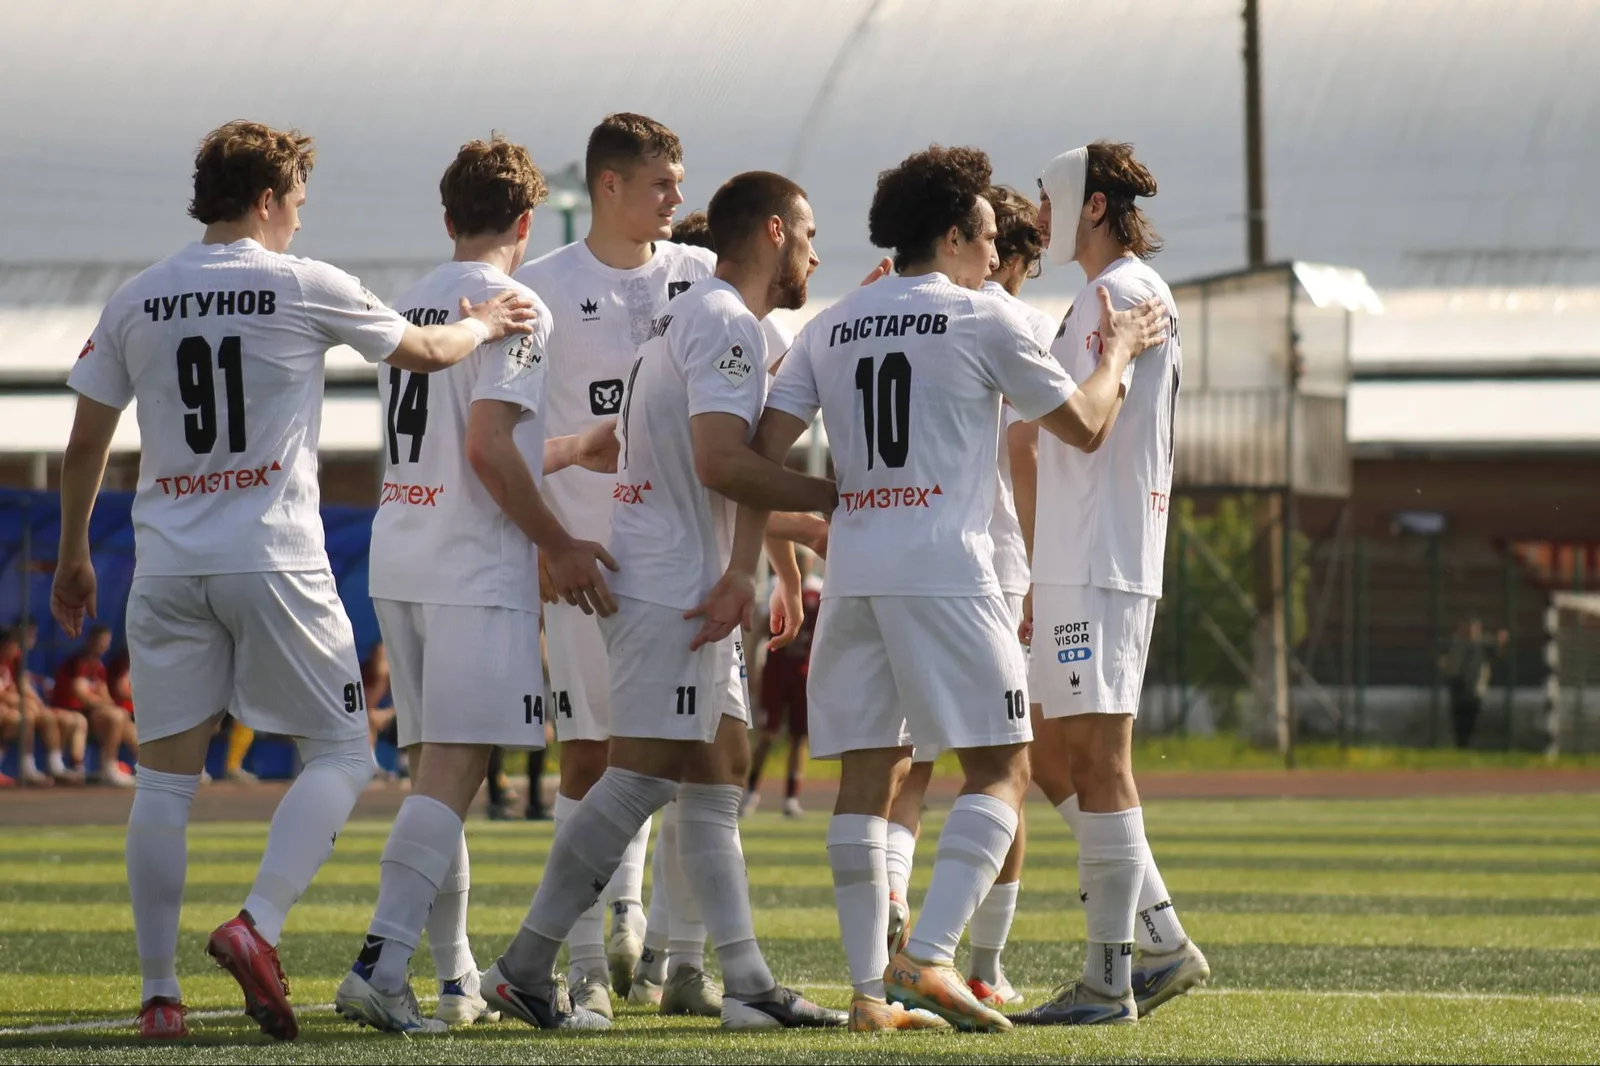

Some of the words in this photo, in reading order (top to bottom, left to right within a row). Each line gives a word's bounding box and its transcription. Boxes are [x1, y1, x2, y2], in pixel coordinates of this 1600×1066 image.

[143, 289, 276, 323] ЧУГУНОВ
[829, 313, 949, 348] ГЫСТАРОВ
[176, 335, 247, 455] 91
[387, 366, 429, 466] 14
[855, 351, 912, 472] 10
[155, 465, 270, 500] тризтех
[1054, 621, 1090, 636] SPORT
[1055, 633, 1090, 647] VISOR
[343, 681, 364, 713] 91
[523, 694, 544, 725] 14
[552, 690, 573, 720] 14
[676, 685, 697, 716] 11
[1004, 689, 1025, 720] 10
